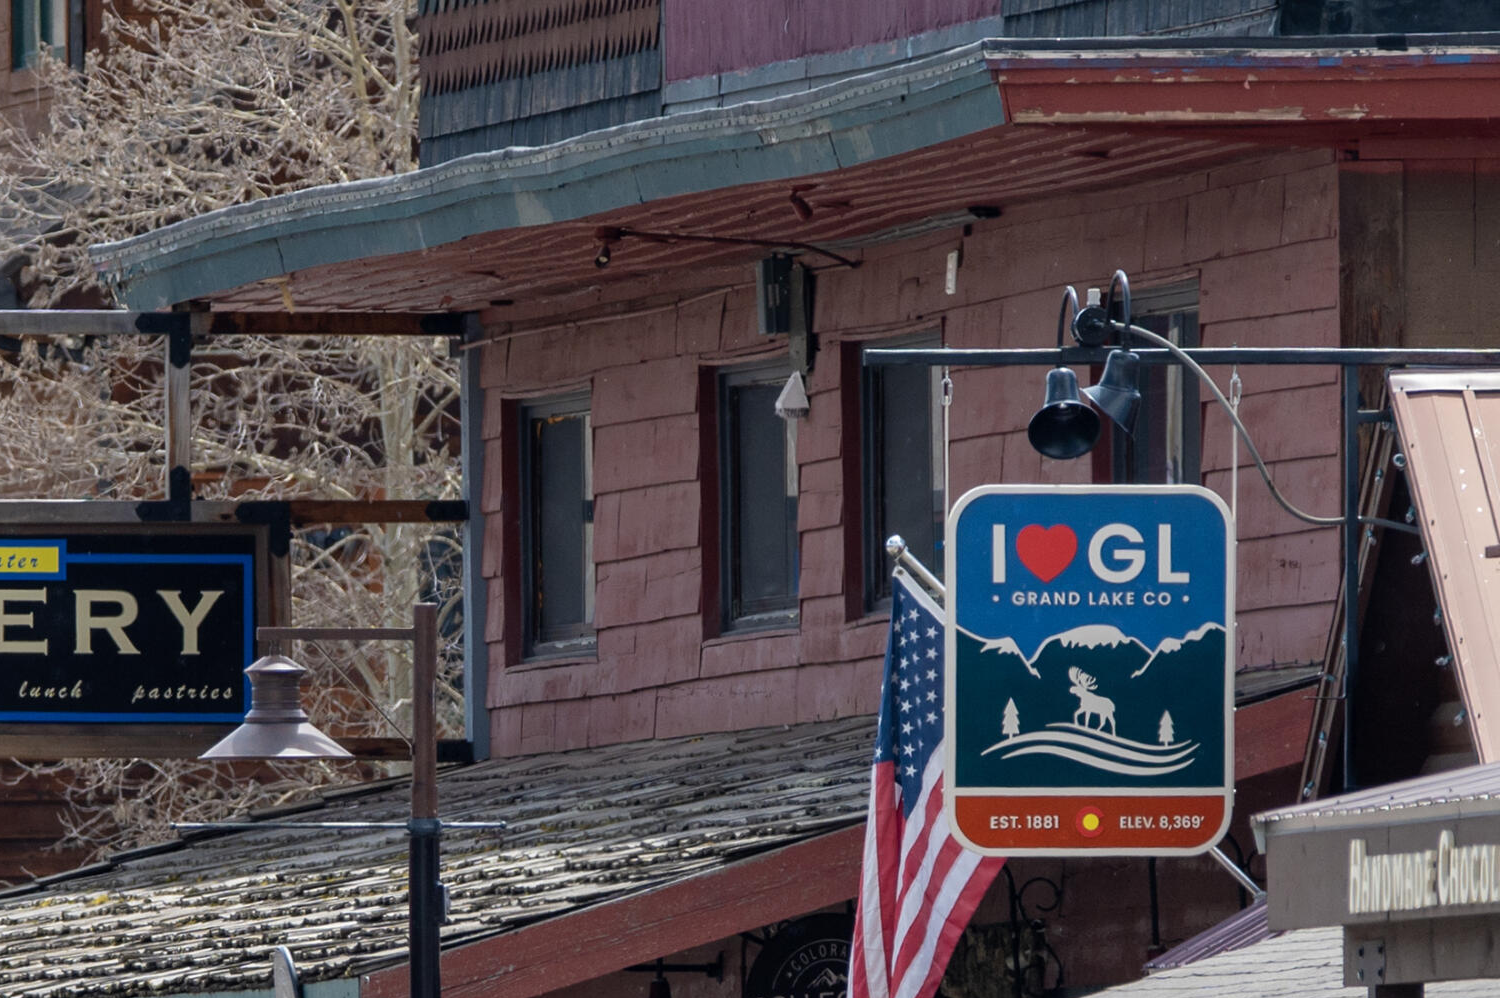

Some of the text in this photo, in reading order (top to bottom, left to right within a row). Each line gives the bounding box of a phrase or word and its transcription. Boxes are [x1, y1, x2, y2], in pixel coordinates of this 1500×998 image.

[992, 522, 1190, 584] I GL
[1011, 591, 1172, 606] GRAND LAKE CO
[19, 680, 84, 699] lunch
[131, 684, 234, 705] pastries
[989, 815, 1060, 830] EST. 1881
[1119, 815, 1155, 830] ELEV.
